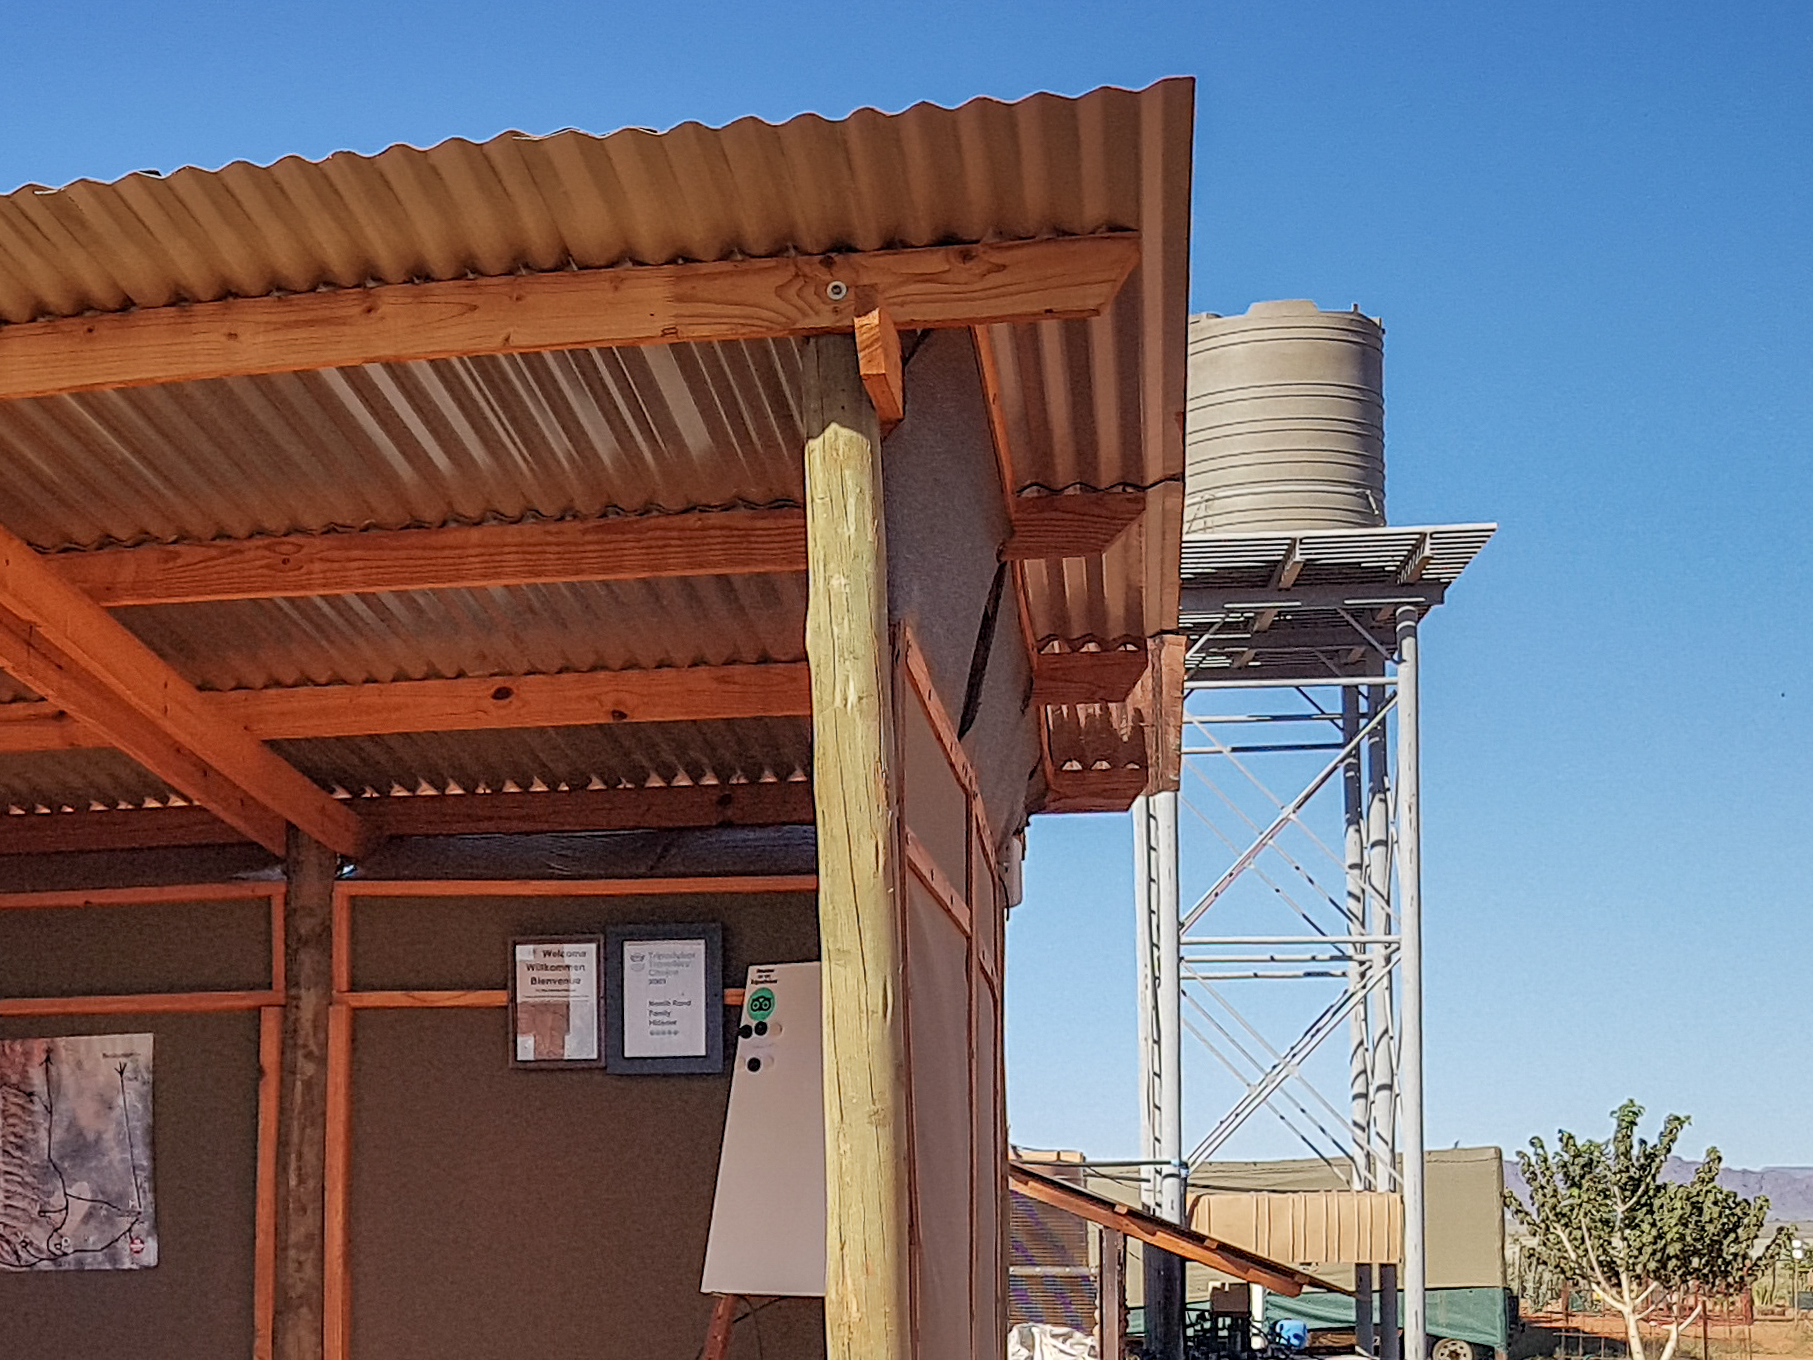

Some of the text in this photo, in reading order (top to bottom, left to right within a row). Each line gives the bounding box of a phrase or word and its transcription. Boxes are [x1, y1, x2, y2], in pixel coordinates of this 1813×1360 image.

[542, 949, 587, 958] Welcome
[526, 963, 586, 972] Willkommen
[530, 976, 582, 985] Bienvenue
